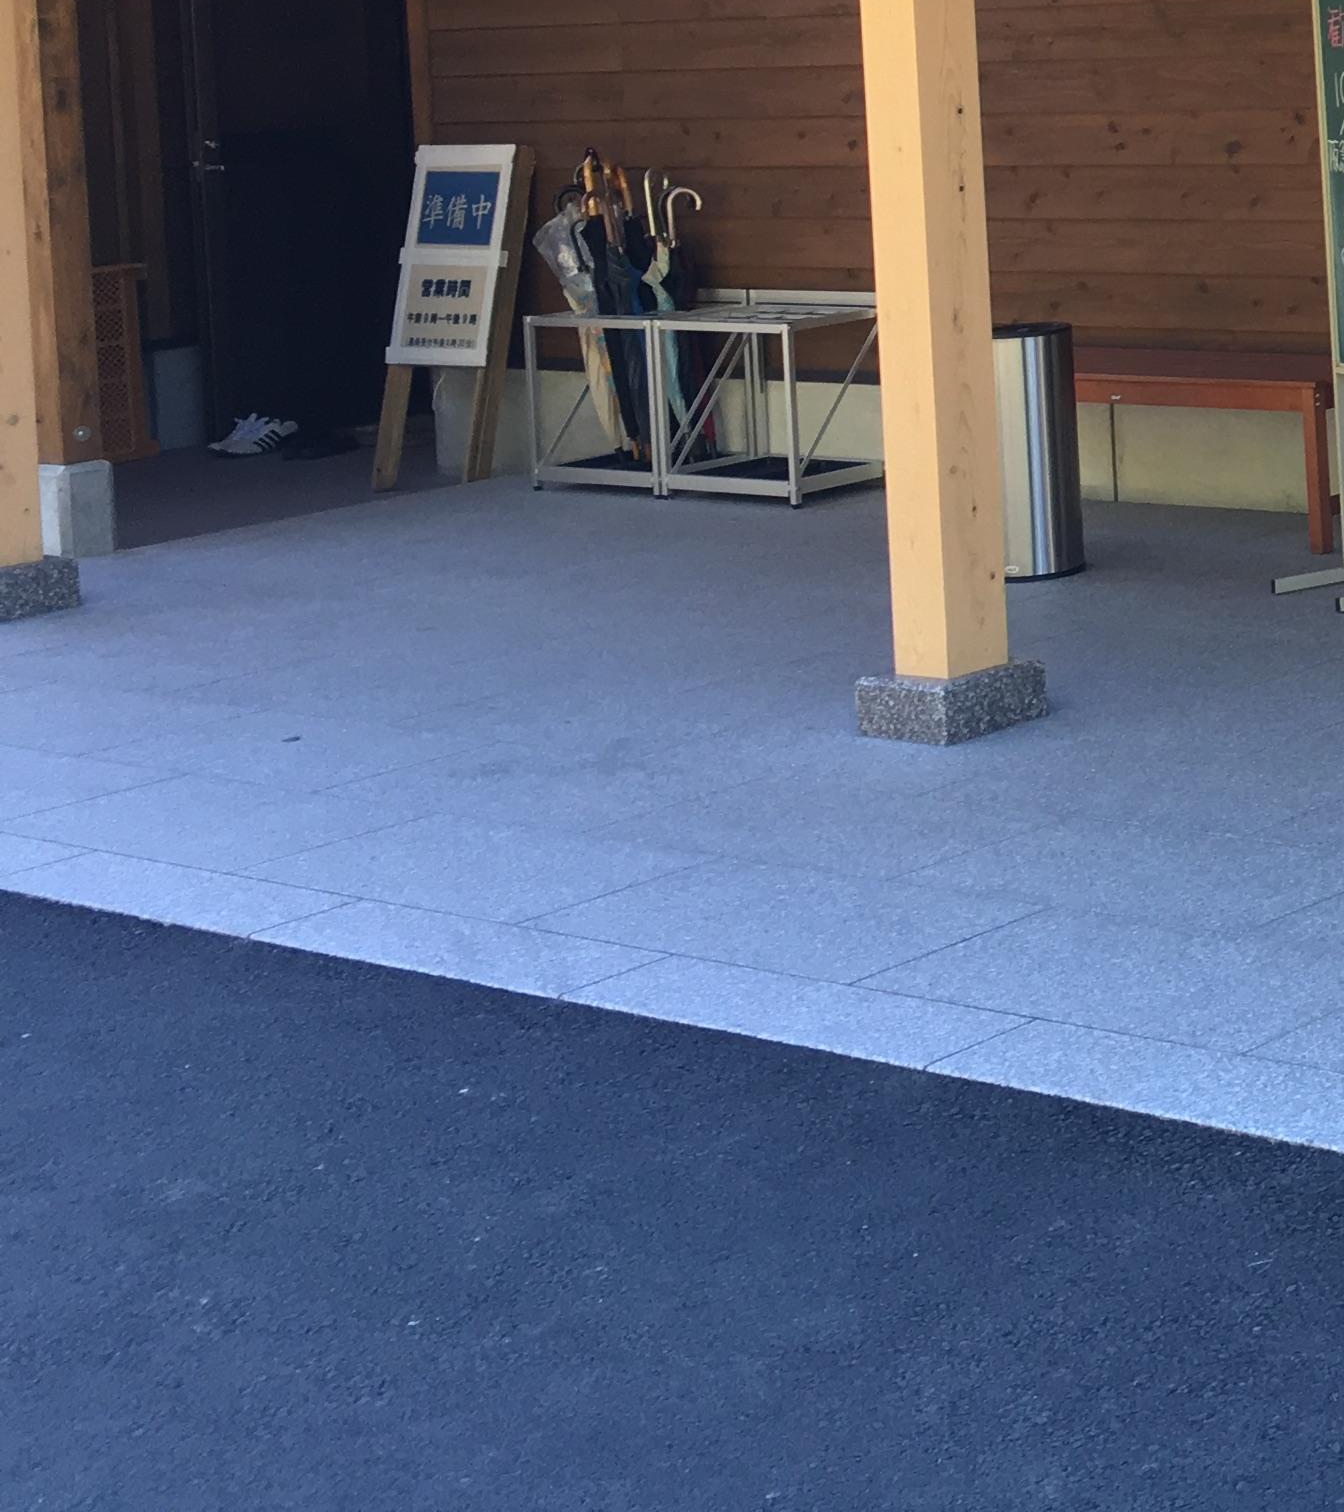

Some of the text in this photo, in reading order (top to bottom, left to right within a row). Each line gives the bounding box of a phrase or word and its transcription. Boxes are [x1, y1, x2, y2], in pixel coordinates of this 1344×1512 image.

[423, 194, 491, 230] 準備中
[421, 279, 471, 298] 営業時間
